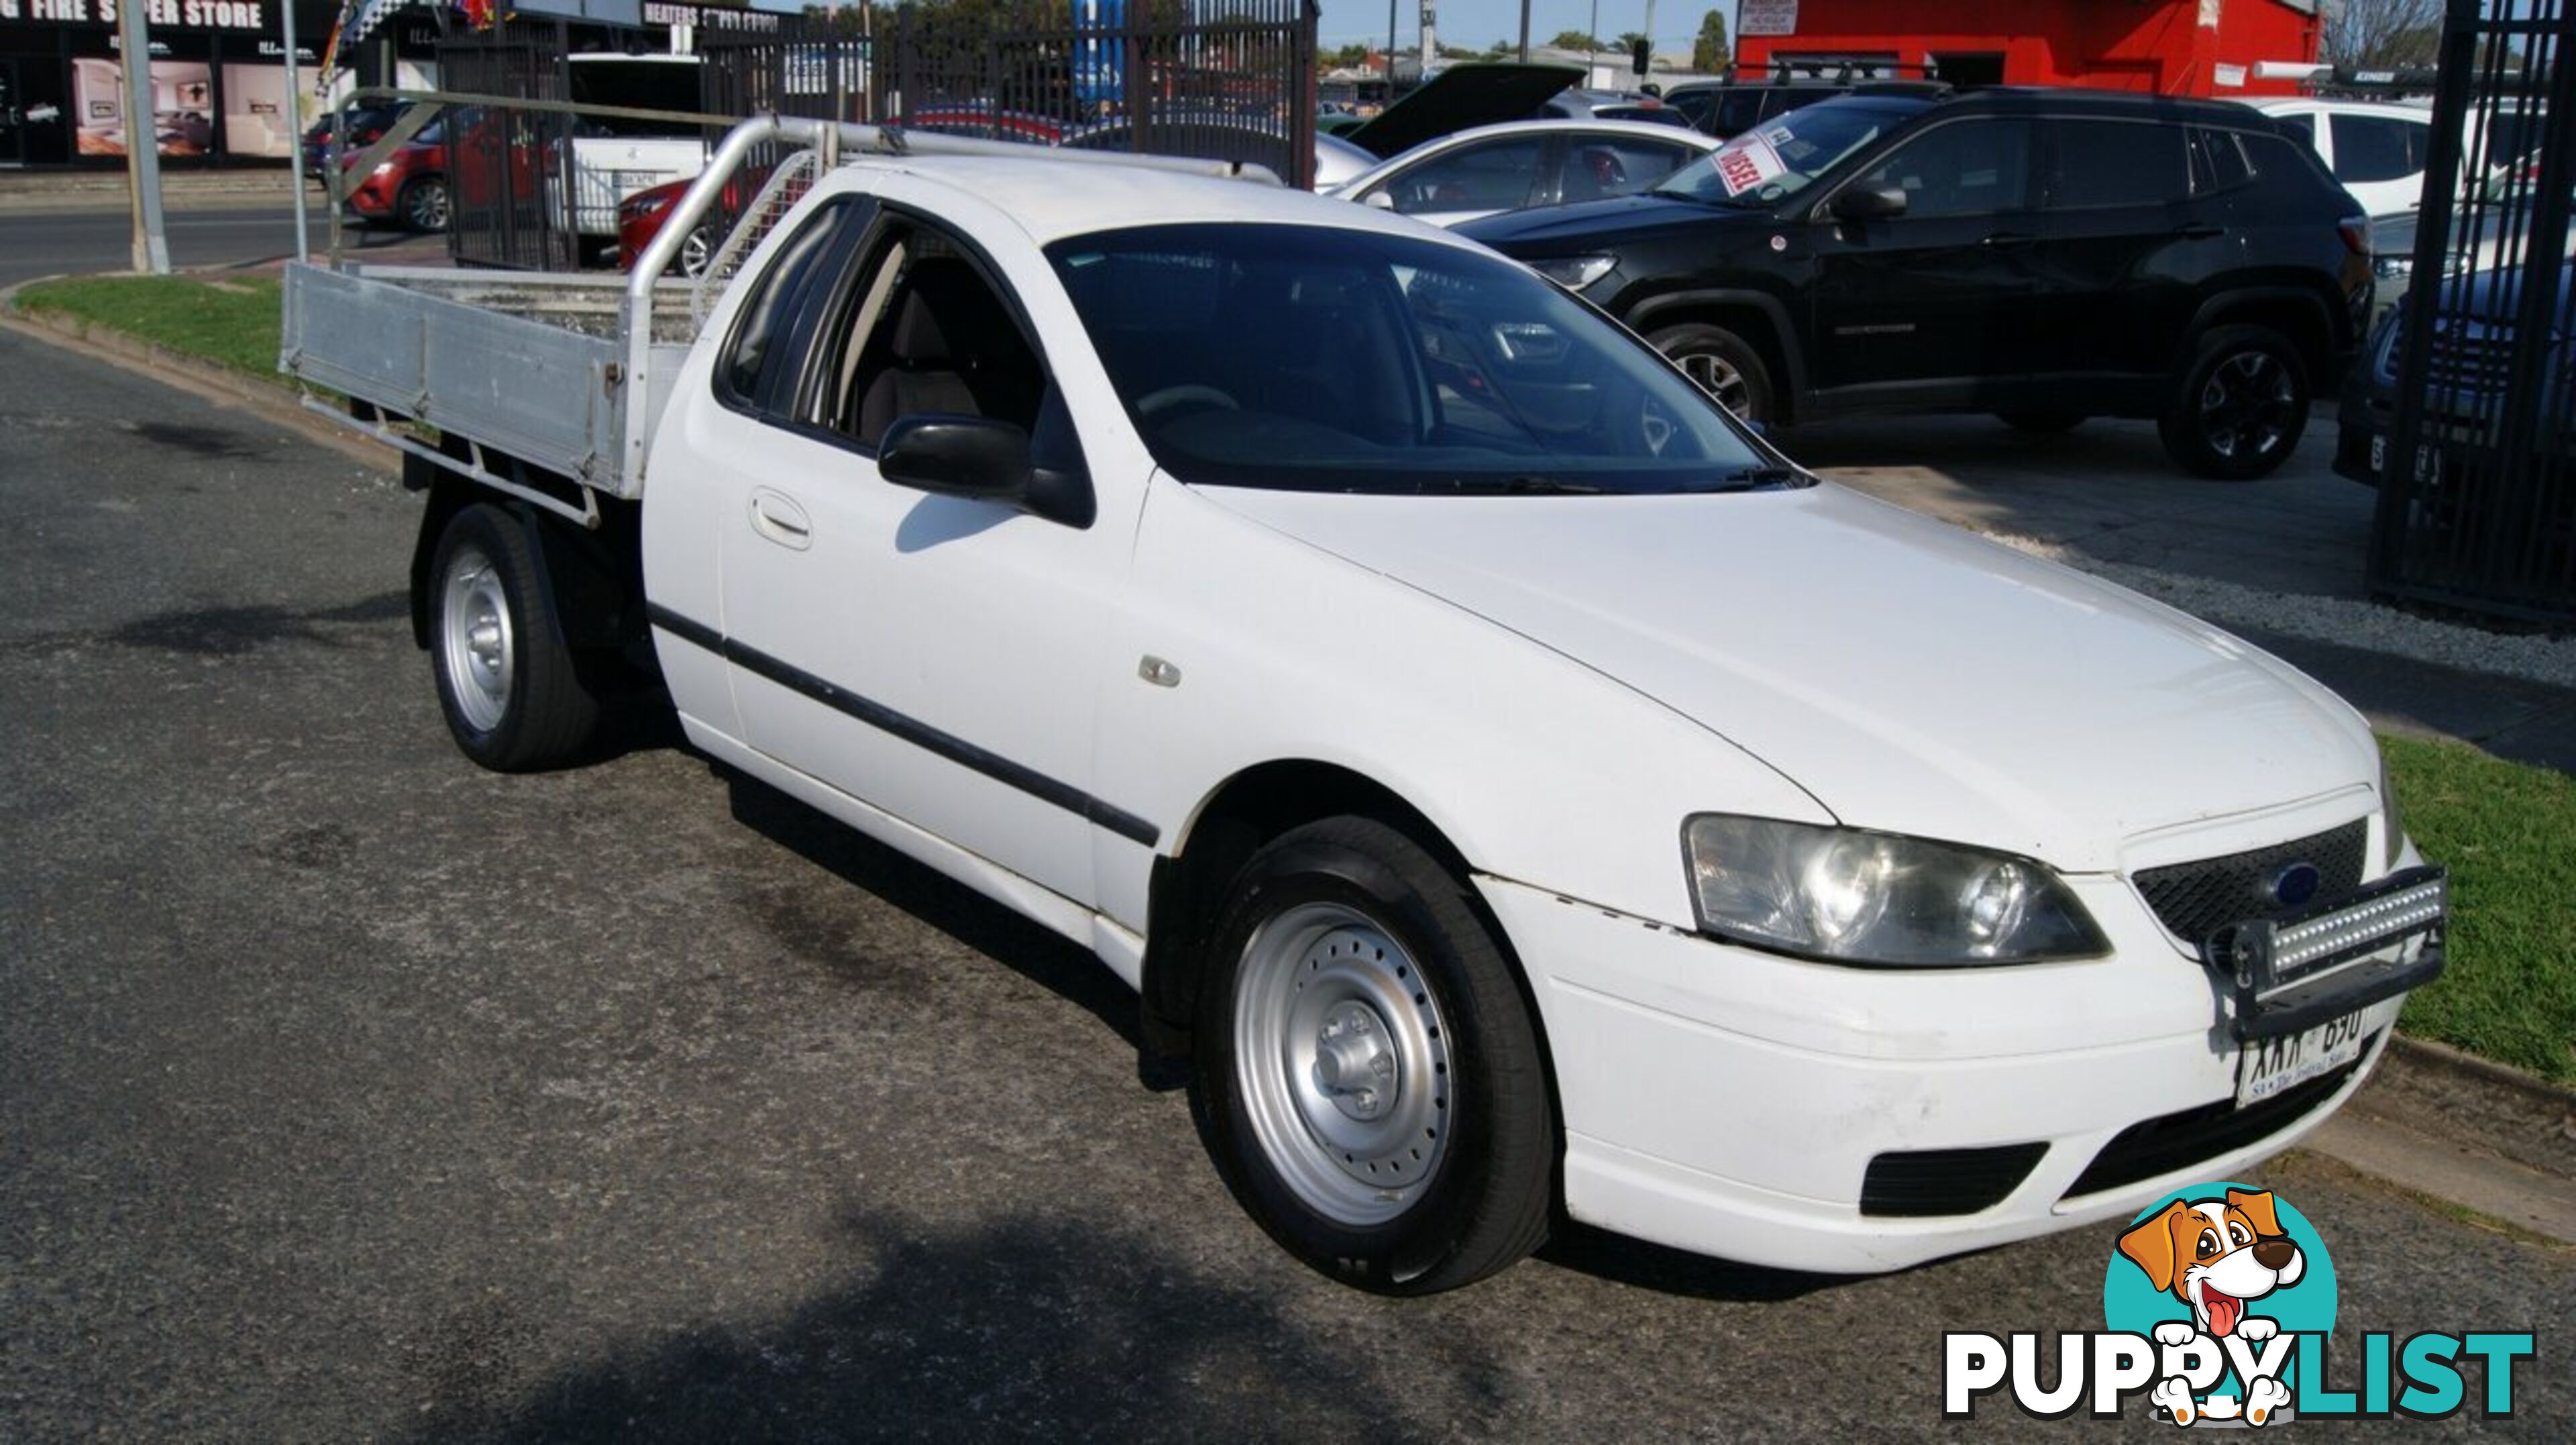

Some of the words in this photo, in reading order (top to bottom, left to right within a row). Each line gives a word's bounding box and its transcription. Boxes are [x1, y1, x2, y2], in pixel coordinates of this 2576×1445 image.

[32, 0, 88, 20] FIRE
[186, 2, 262, 28] STORE
[645, 3, 698, 26] HEATERS
[2354, 71, 2395, 82] KINGS
[1719, 148, 1762, 190] DIESEL
